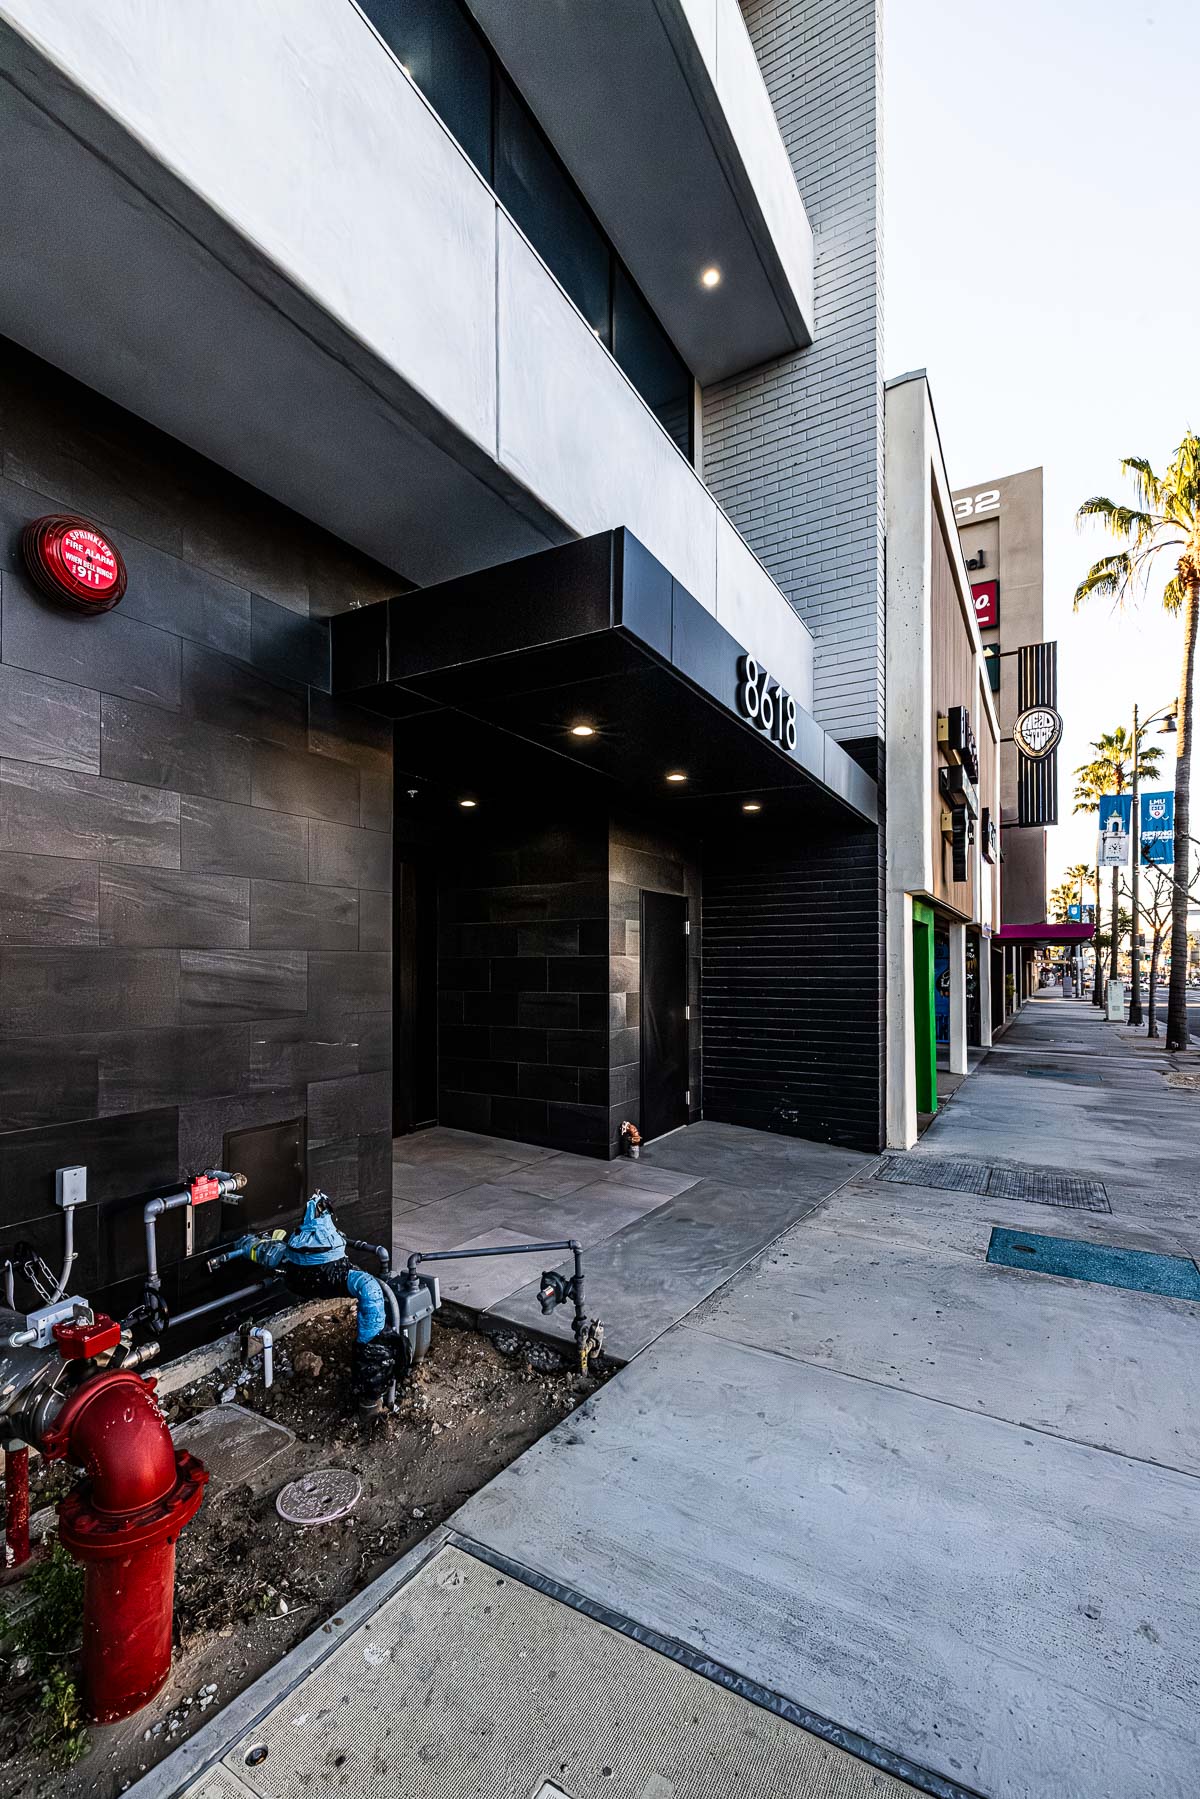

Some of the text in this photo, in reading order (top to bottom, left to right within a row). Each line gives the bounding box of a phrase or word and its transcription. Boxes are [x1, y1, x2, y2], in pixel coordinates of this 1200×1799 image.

[65, 538, 114, 567] FIRE ALARM
[69, 531, 112, 557] SPRINKLER
[65, 551, 83, 566] WHEN
[83, 560, 96, 572] BELL
[96, 566, 113, 580] RINGS
[77, 565, 99, 585] 911
[738, 654, 797, 751] 8618
[1022, 727, 1055, 750] STOCK
